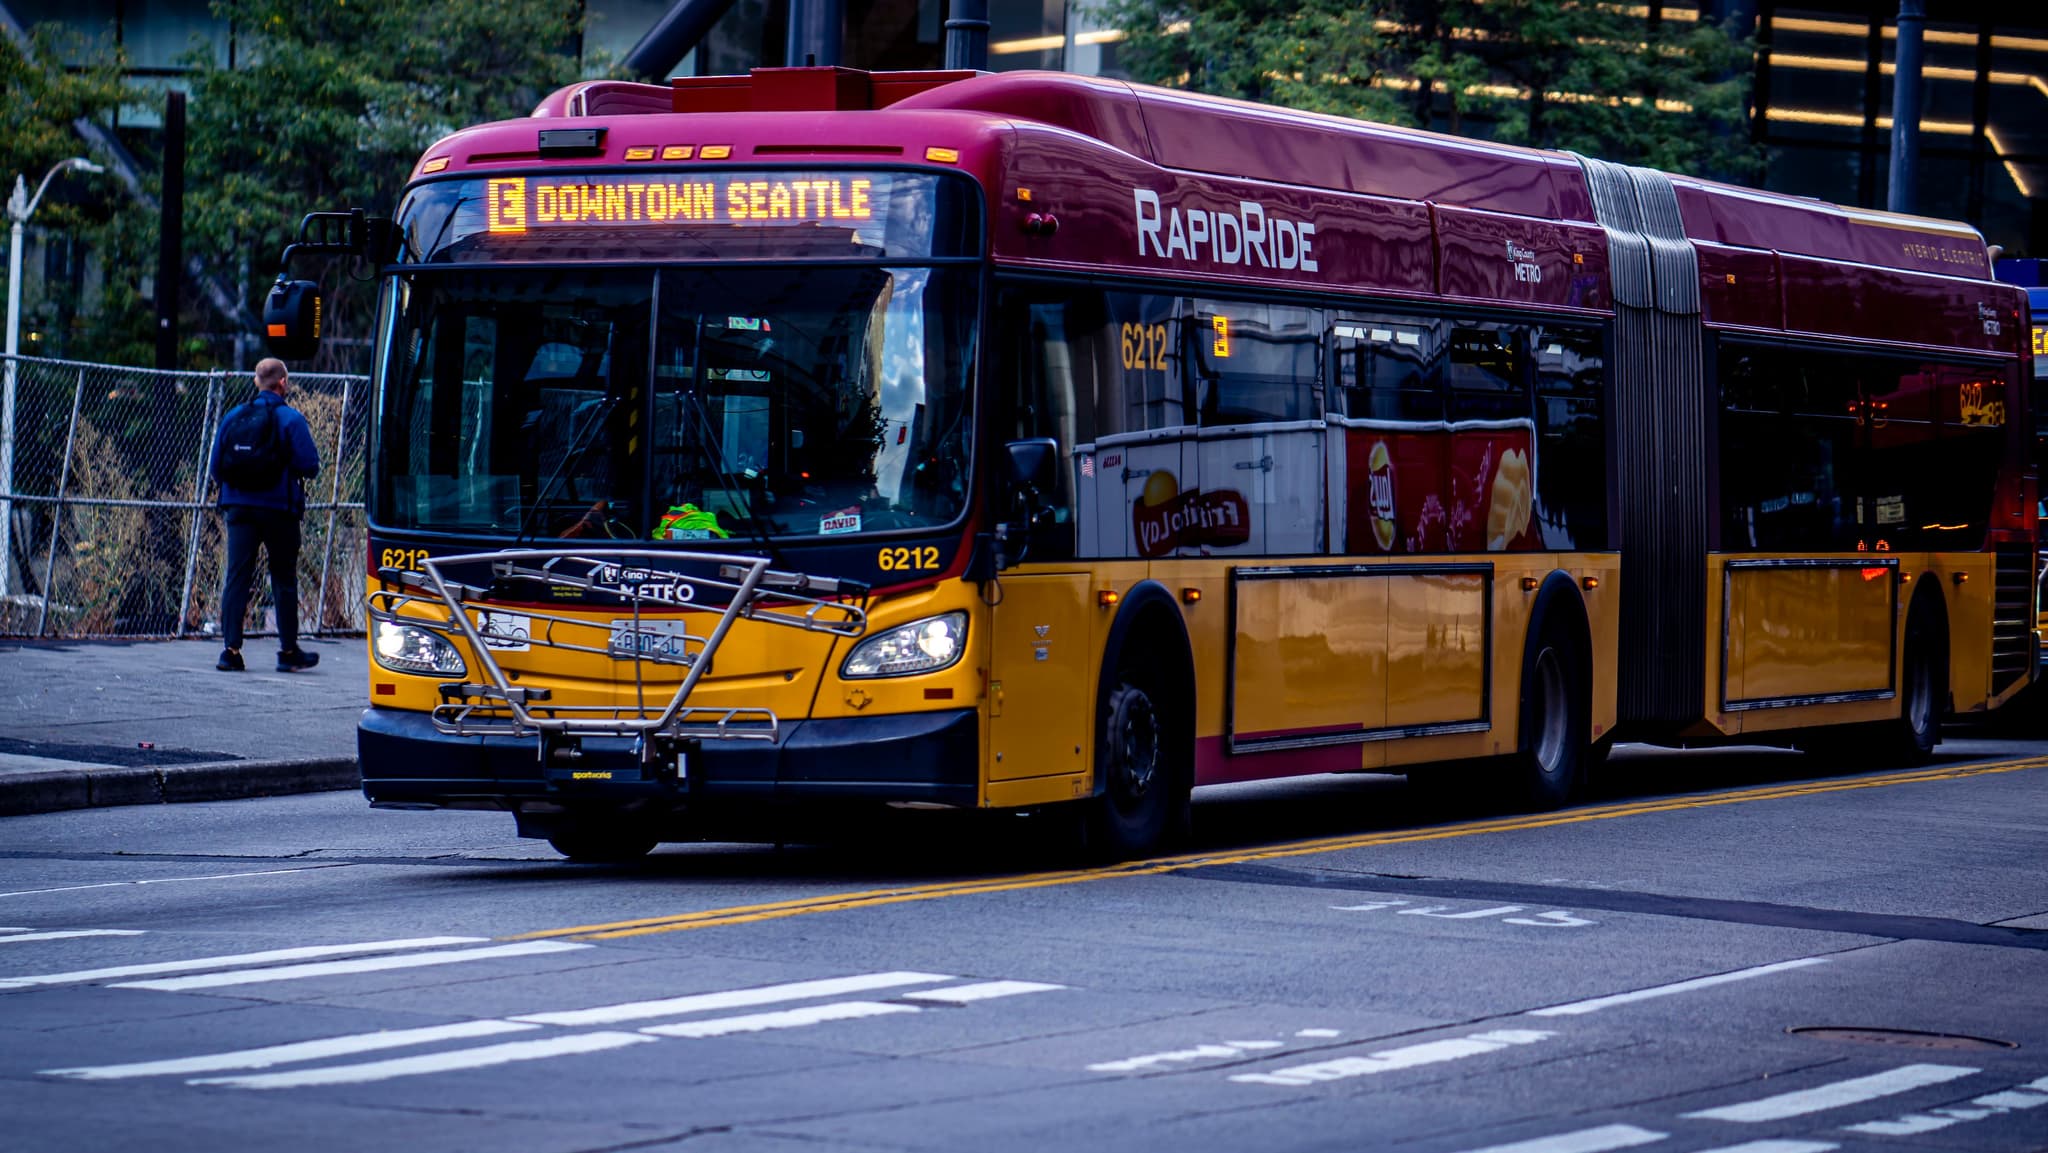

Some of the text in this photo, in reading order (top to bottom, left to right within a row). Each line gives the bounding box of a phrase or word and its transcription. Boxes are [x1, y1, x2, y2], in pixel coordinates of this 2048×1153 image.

[537, 184, 714, 222] DOWNTOWN
[727, 180, 871, 219] SEATTLE
[1902, 242, 1985, 267] HYBRID ELECTRIC
[1514, 262, 1541, 283] METRO
[1121, 322, 1168, 370] 6212
[1960, 383, 1983, 415] 6212
[824, 517, 857, 531] DAVID
[878, 546, 939, 570] 6212
